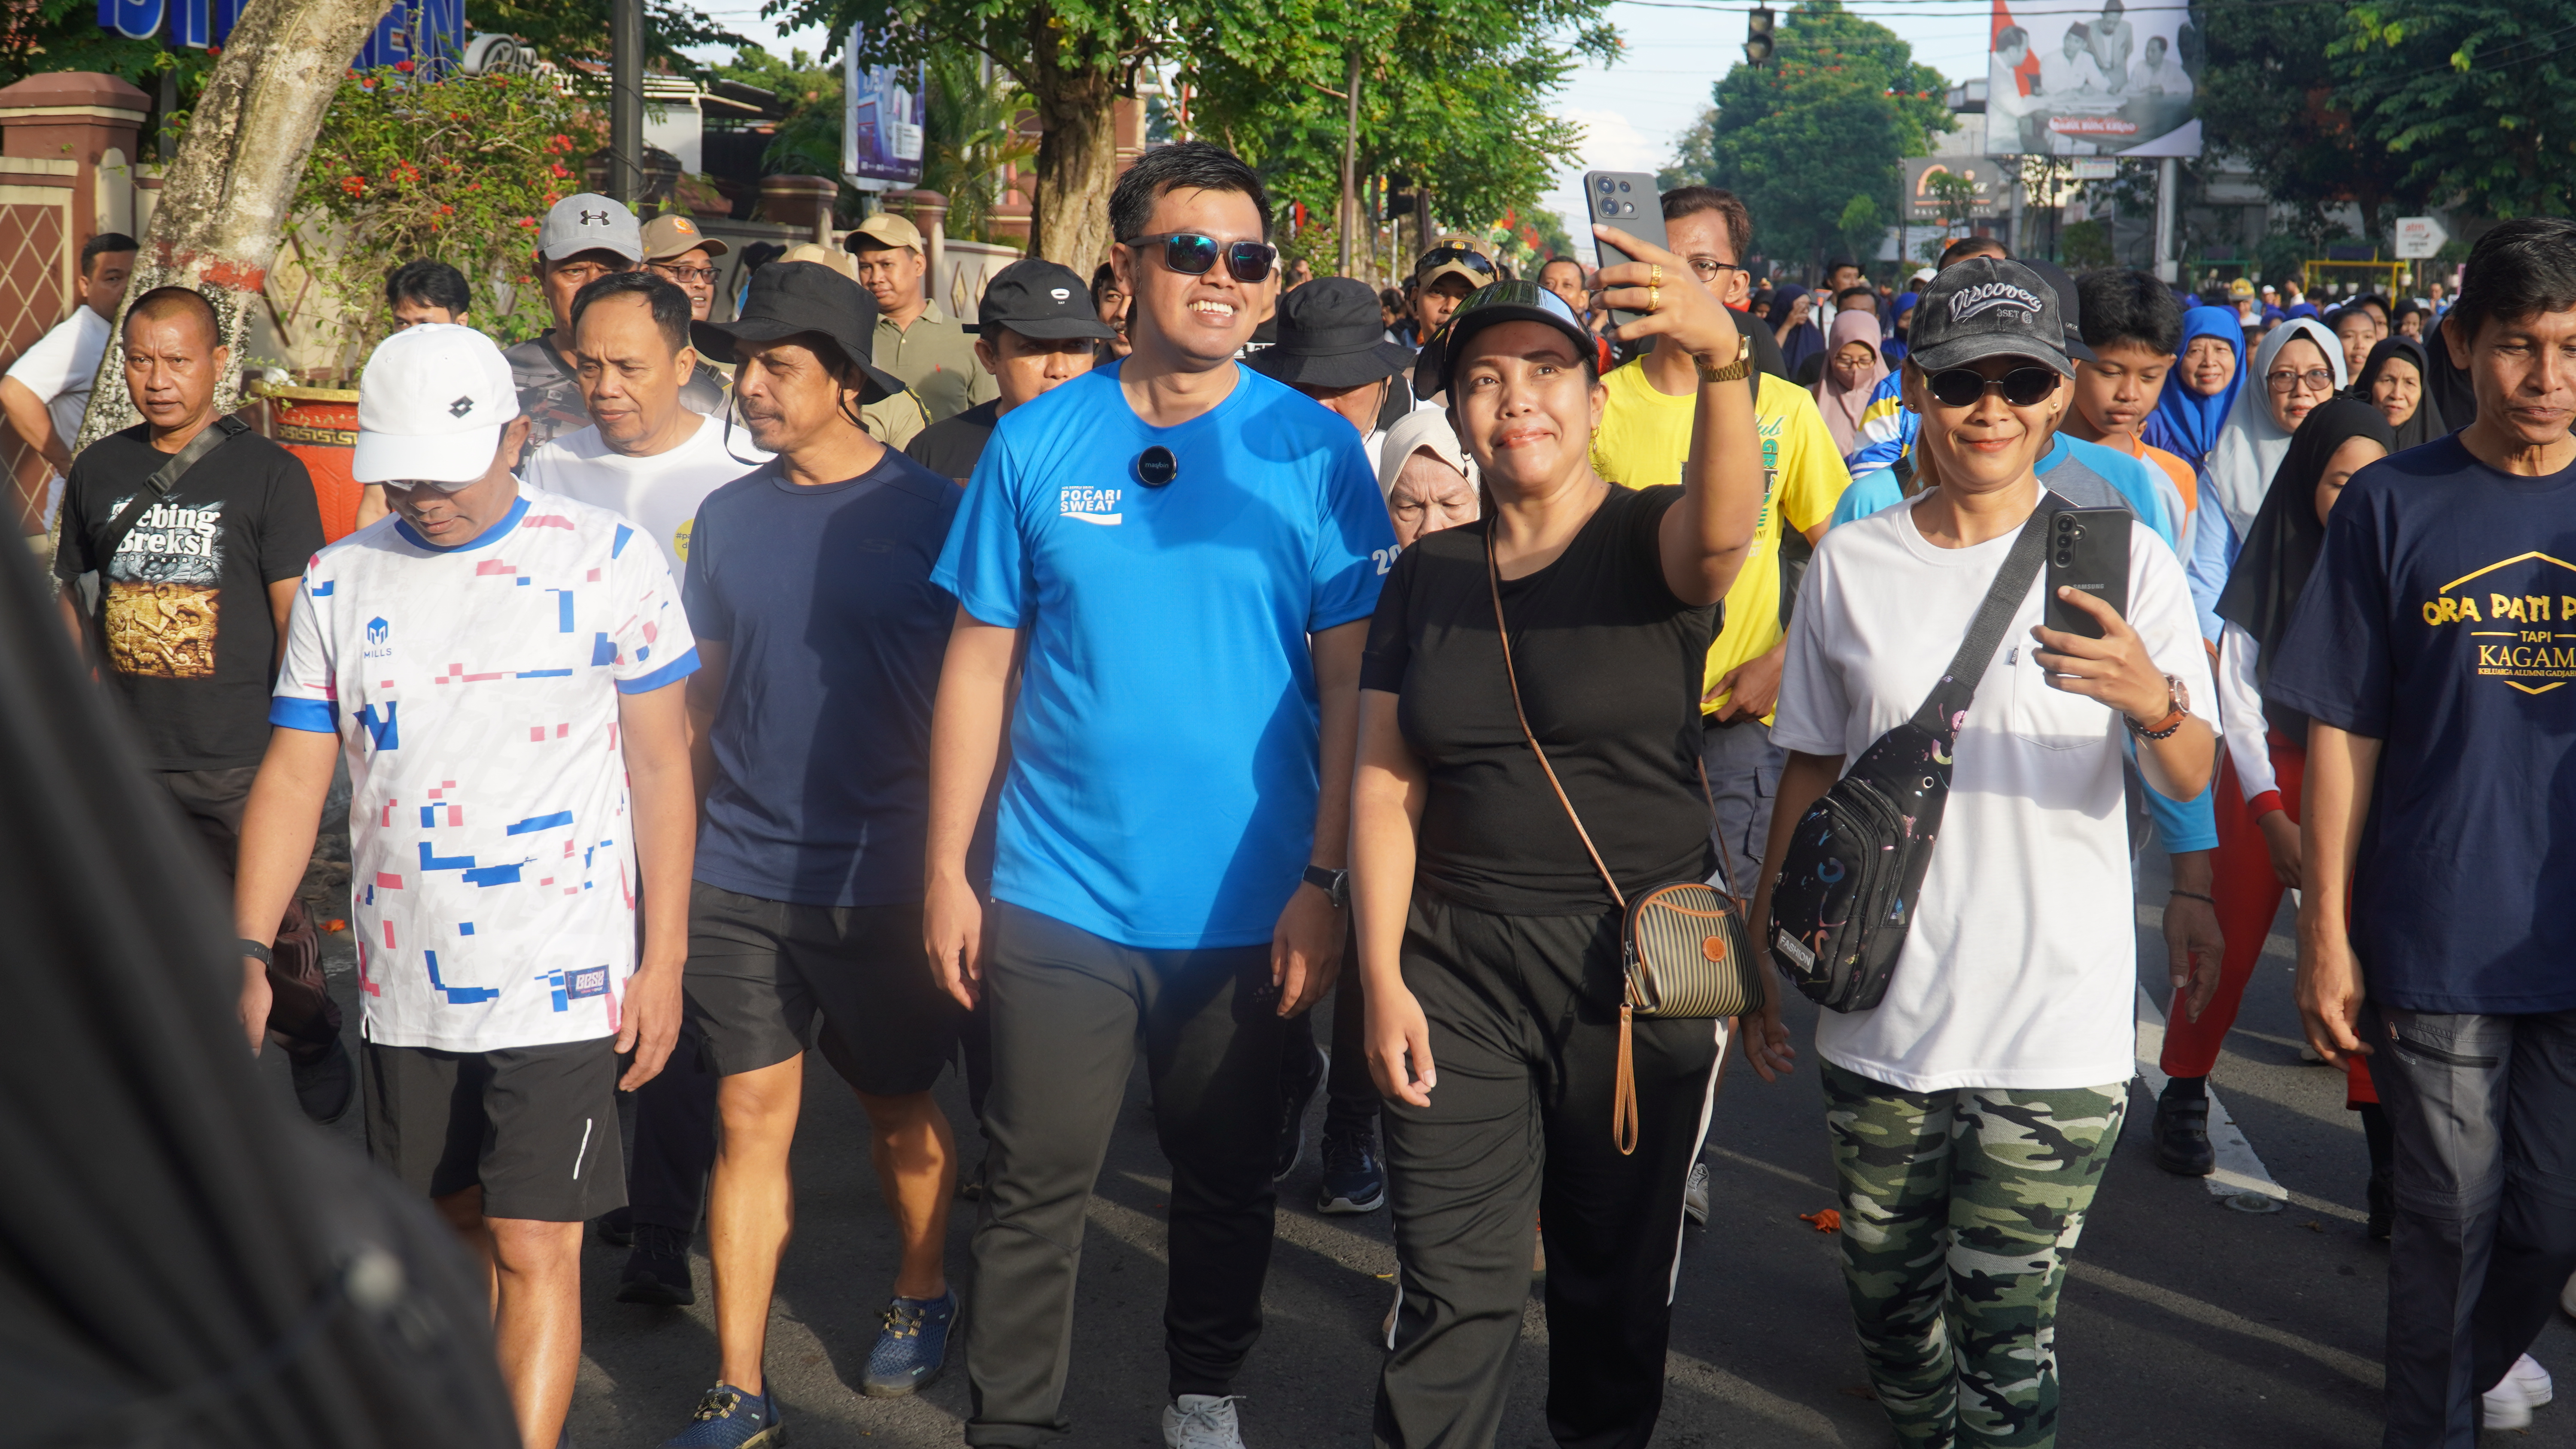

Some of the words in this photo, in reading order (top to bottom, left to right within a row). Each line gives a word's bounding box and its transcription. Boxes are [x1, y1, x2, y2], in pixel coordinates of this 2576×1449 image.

[1061, 489, 1121, 501] POCARI
[1060, 500, 1115, 512] SWEAT
[115, 528, 213, 557] Breksi
[113, 555, 212, 567] YOGYAKARTA
[2423, 597, 2482, 626] ORA
[2491, 593, 2551, 623] PATI
[2520, 631, 2552, 643] TAPI
[364, 648, 392, 659] MILLS
[1780, 935, 1811, 966] FASHION
